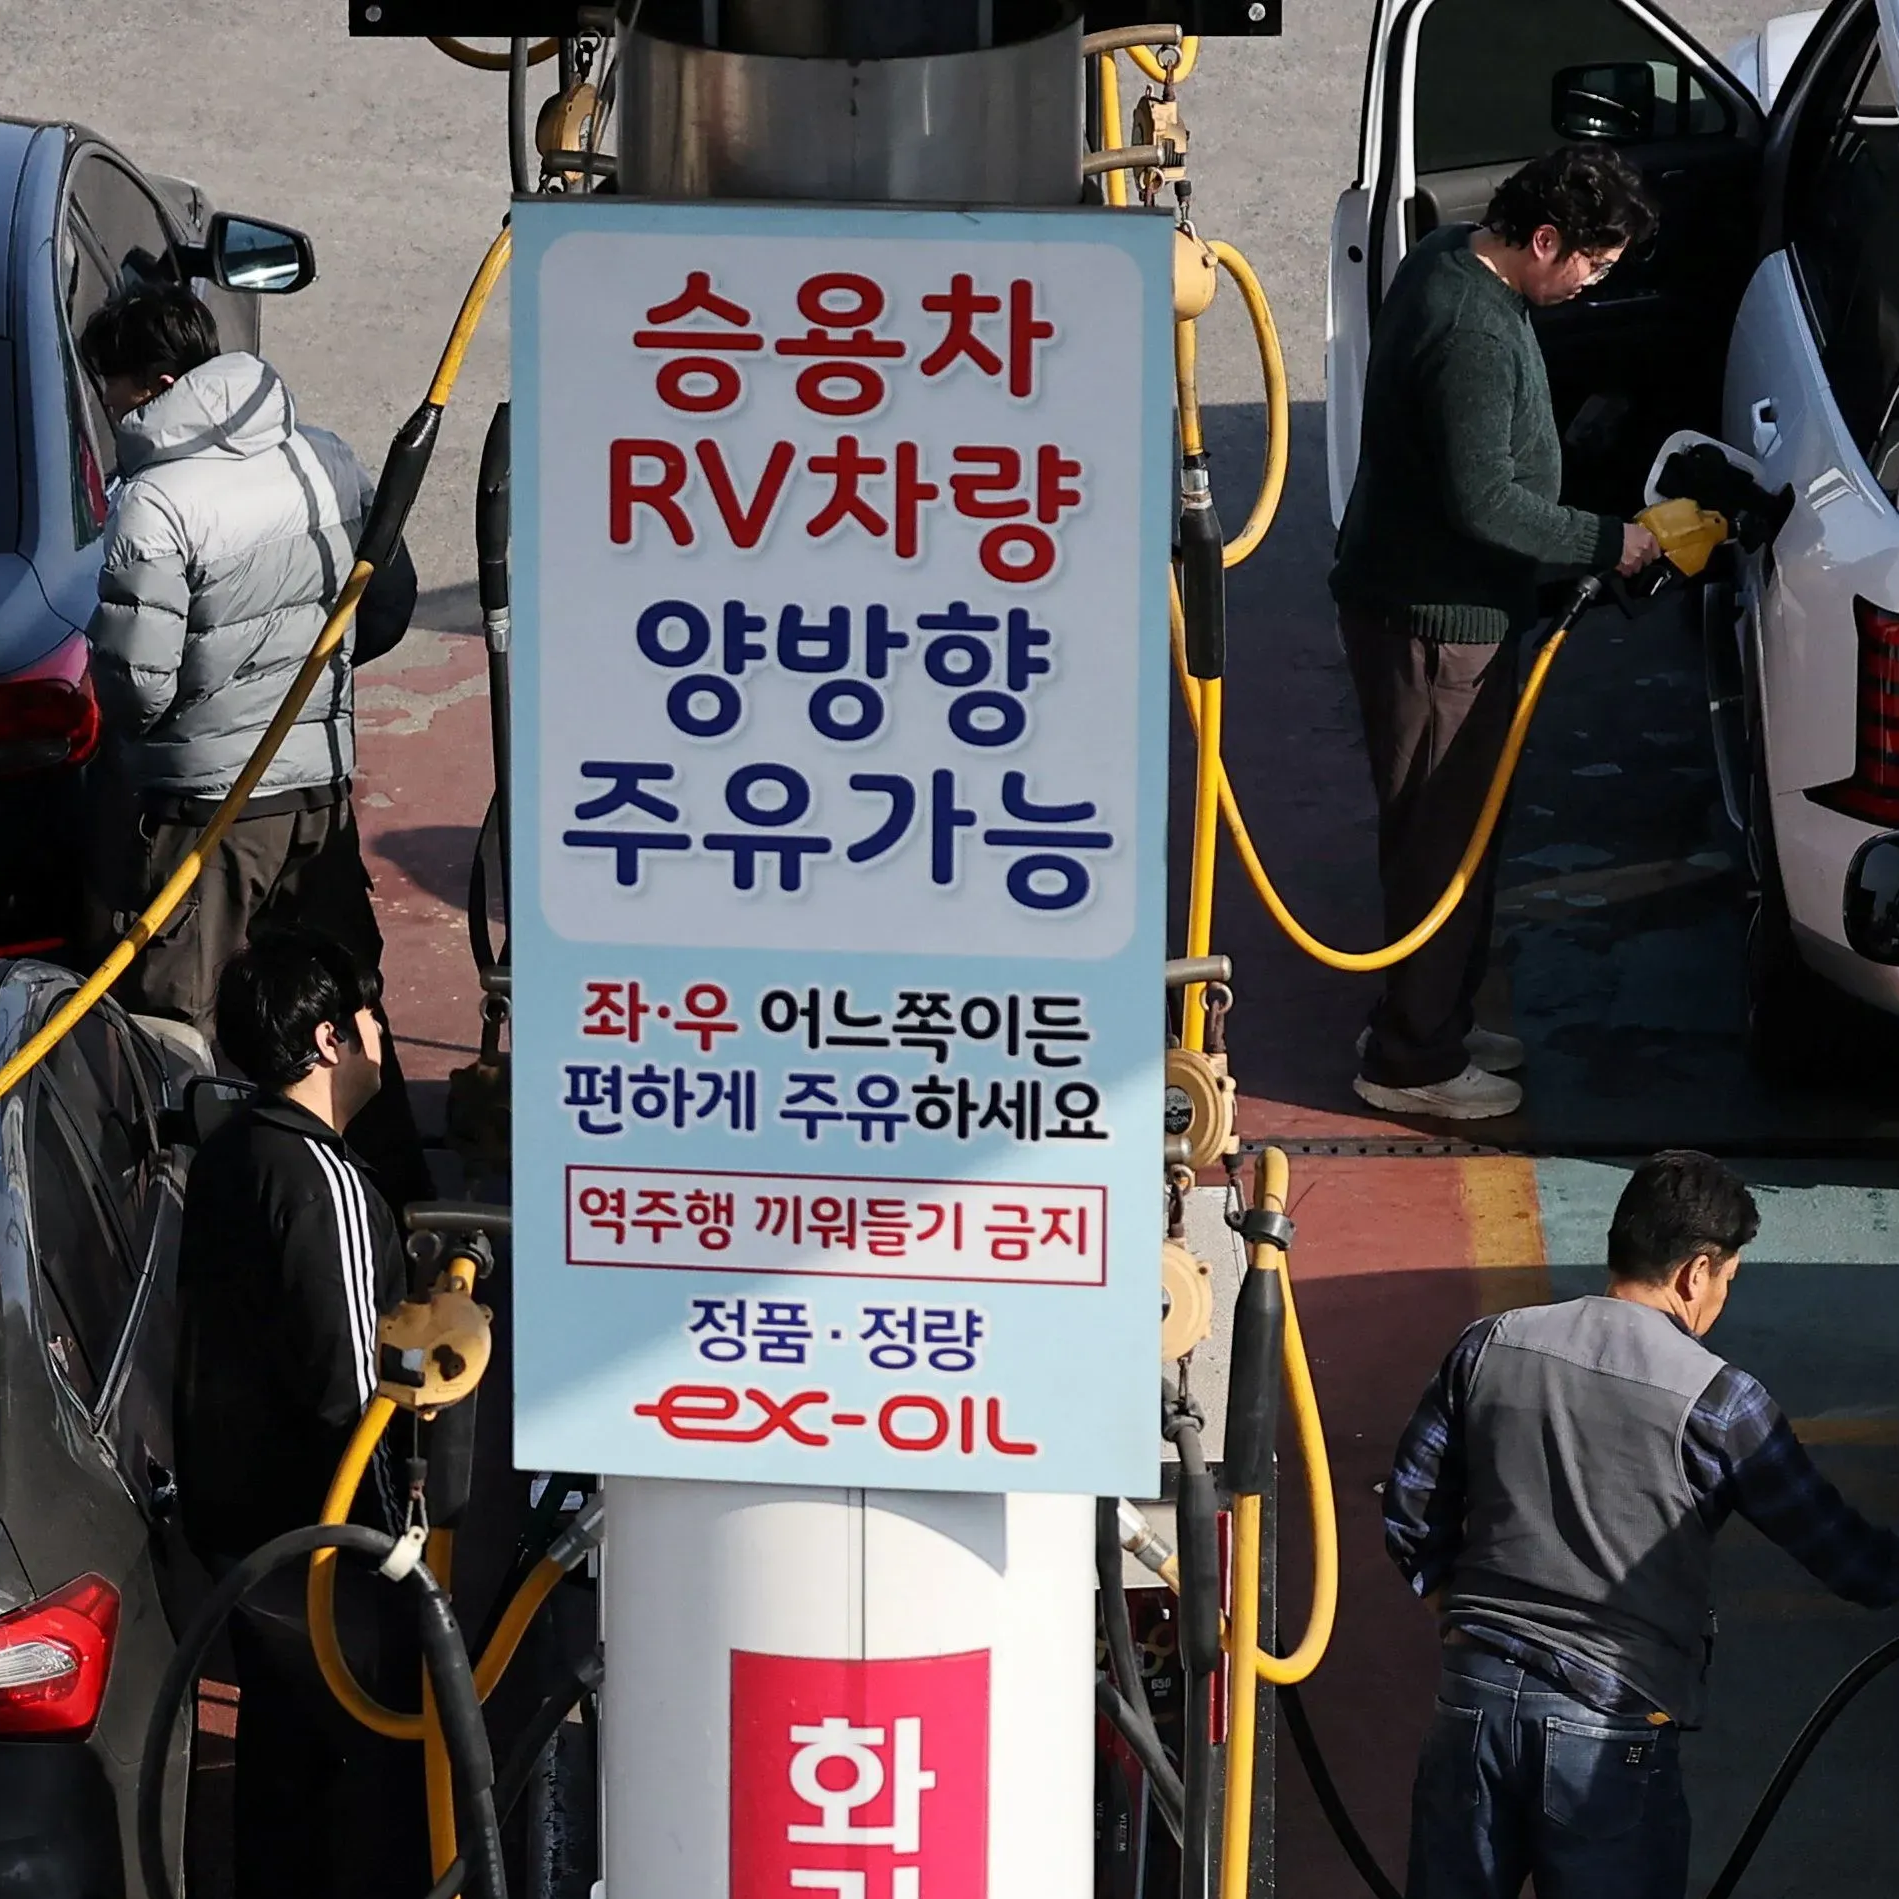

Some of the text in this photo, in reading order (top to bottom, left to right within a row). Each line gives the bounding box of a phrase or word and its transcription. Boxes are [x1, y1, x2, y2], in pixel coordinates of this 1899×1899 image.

[634, 271, 1054, 415] 승용차
[609, 436, 1081, 582] RV차량
[637, 600, 1050, 746] 양방향
[563, 762, 1113, 909] 주유가능
[583, 981, 1090, 1066] 좌·우 어느쪽이든
[565, 1065, 1108, 1142] 편하게 주유하세요
[579, 1187, 1088, 1260] 역주행 끼워들기 금지
